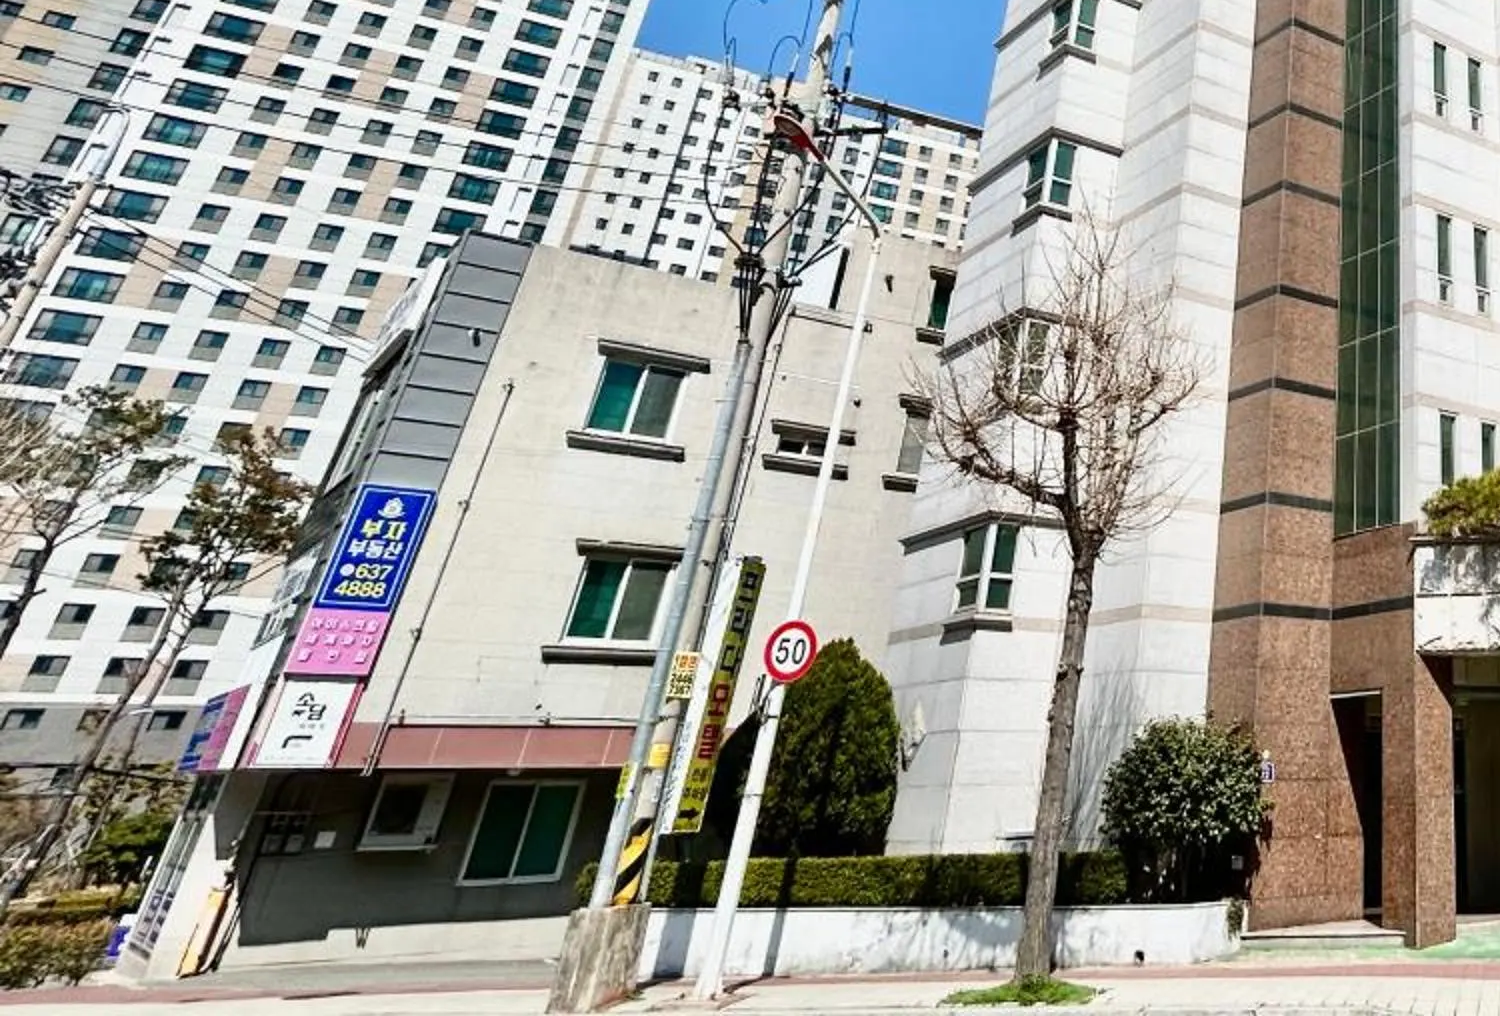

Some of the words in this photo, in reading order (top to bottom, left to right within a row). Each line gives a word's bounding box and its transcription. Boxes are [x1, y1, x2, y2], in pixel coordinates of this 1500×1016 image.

[361, 519, 406, 540] 부자
[348, 539, 403, 560] 부동산
[356, 564, 393, 580] 637
[334, 581, 386, 598] 4888
[776, 638, 807, 664] 50
